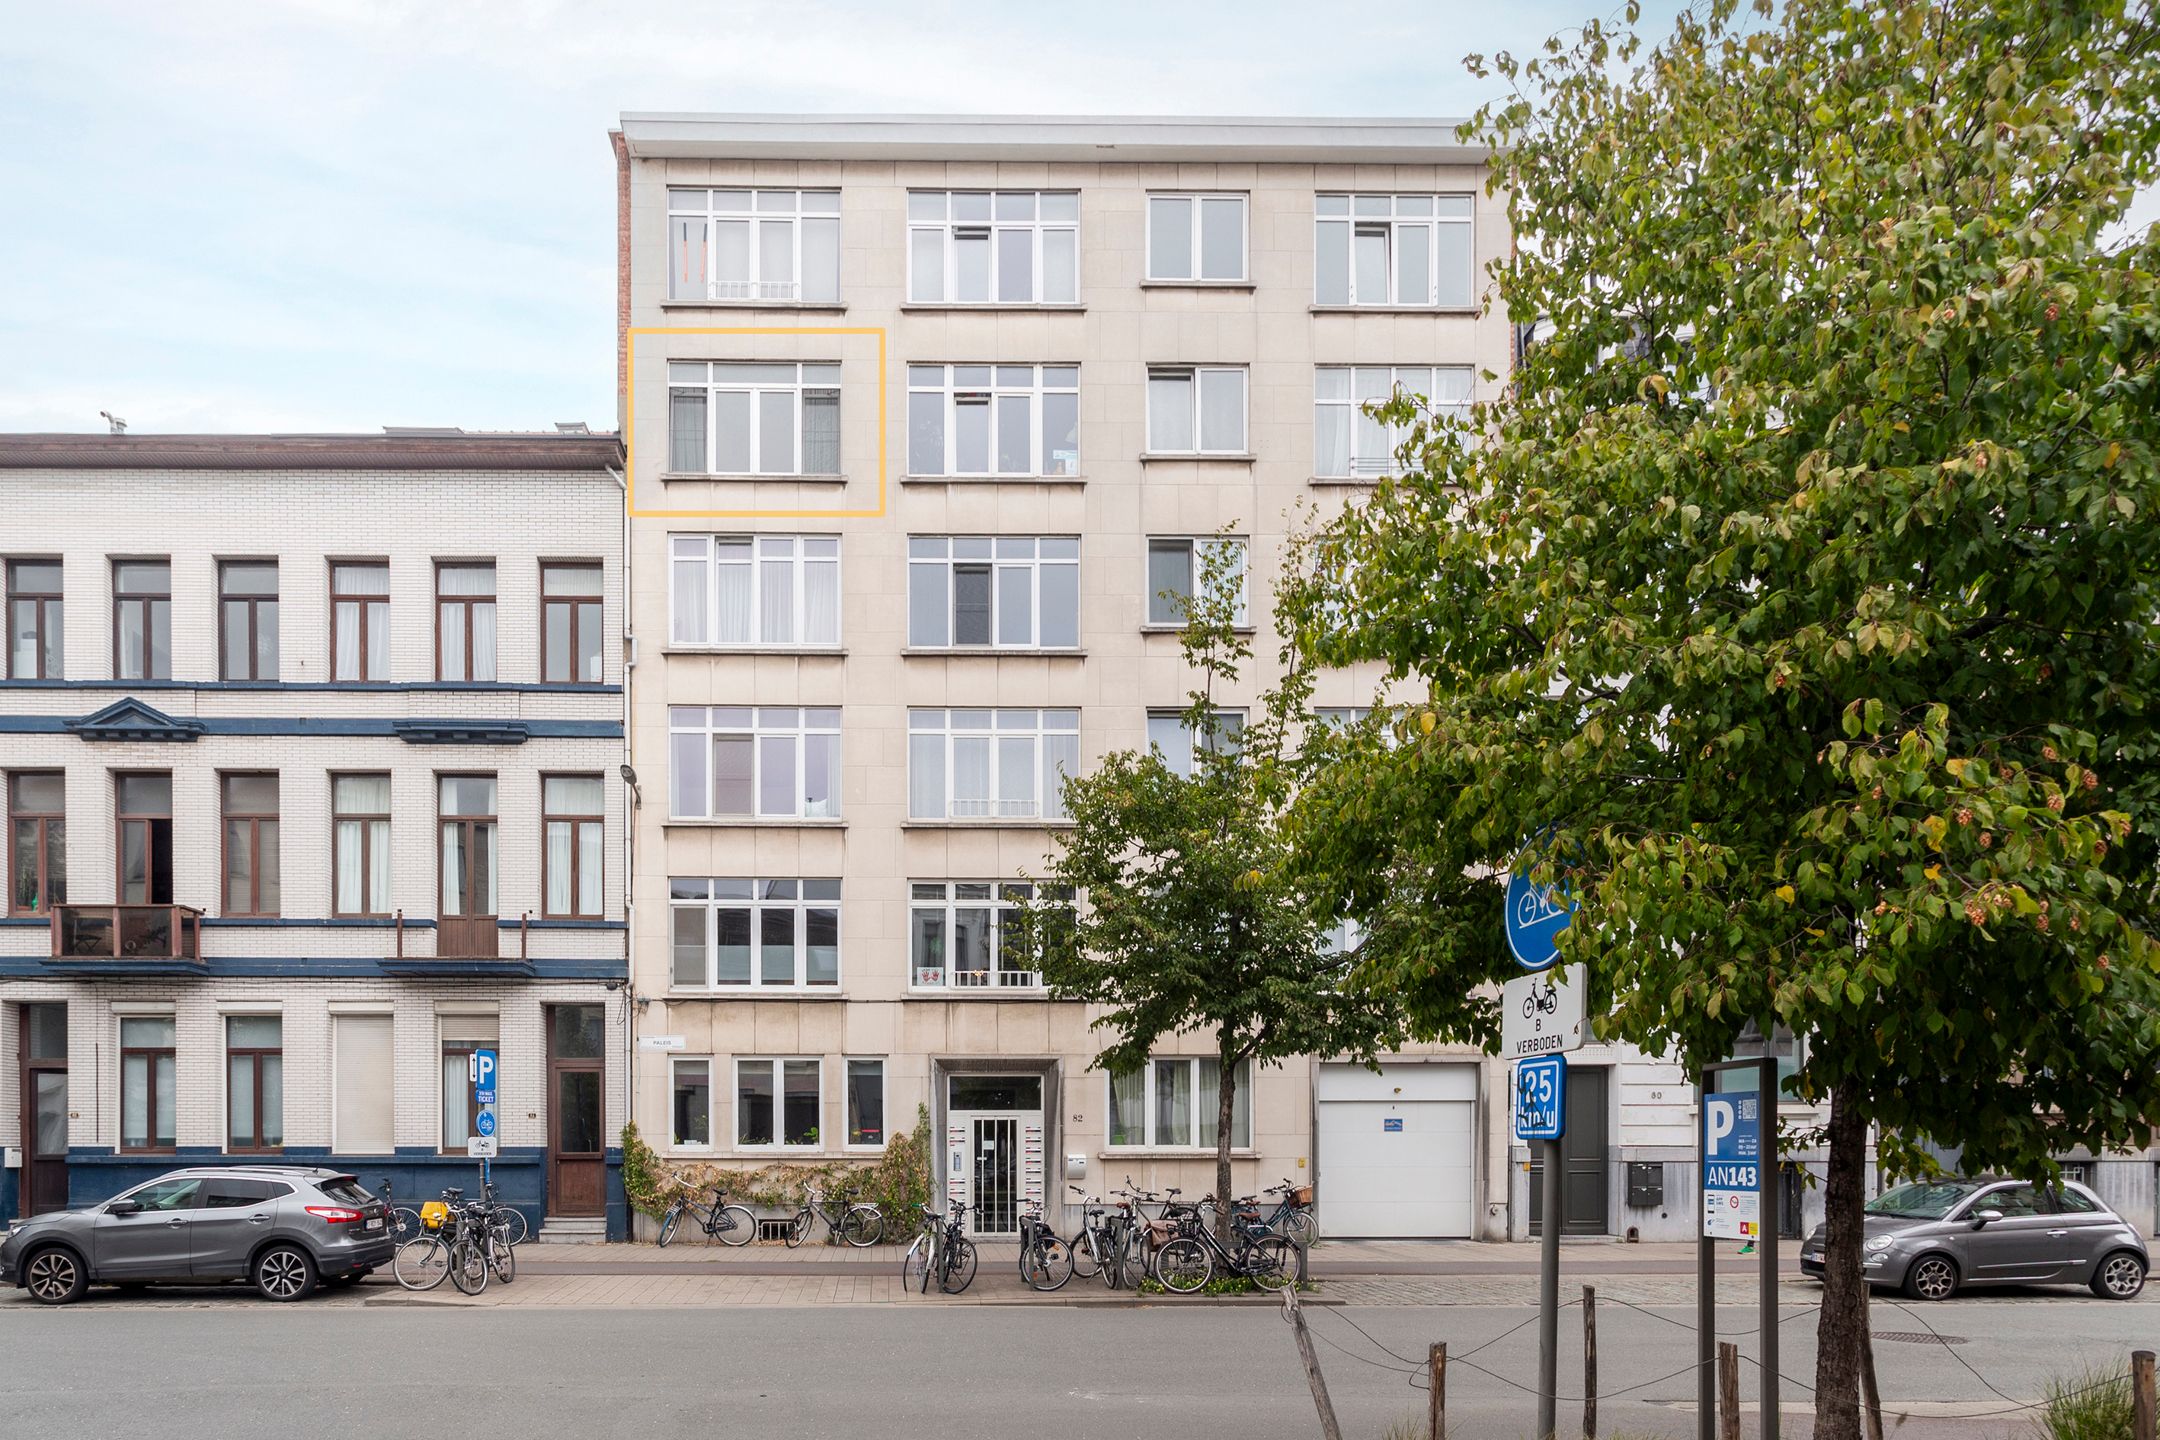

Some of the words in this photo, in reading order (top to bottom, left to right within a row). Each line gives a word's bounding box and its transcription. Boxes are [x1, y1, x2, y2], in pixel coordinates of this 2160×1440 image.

[1535, 1018, 1542, 1032] B
[1516, 1034, 1563, 1054] VERBODEN
[479, 1055, 494, 1084] P
[1525, 1069, 1552, 1104] 25
[1072, 1114, 1083, 1122] 82
[1707, 1100, 1735, 1156] P
[1707, 1166, 1757, 1187] AN143
